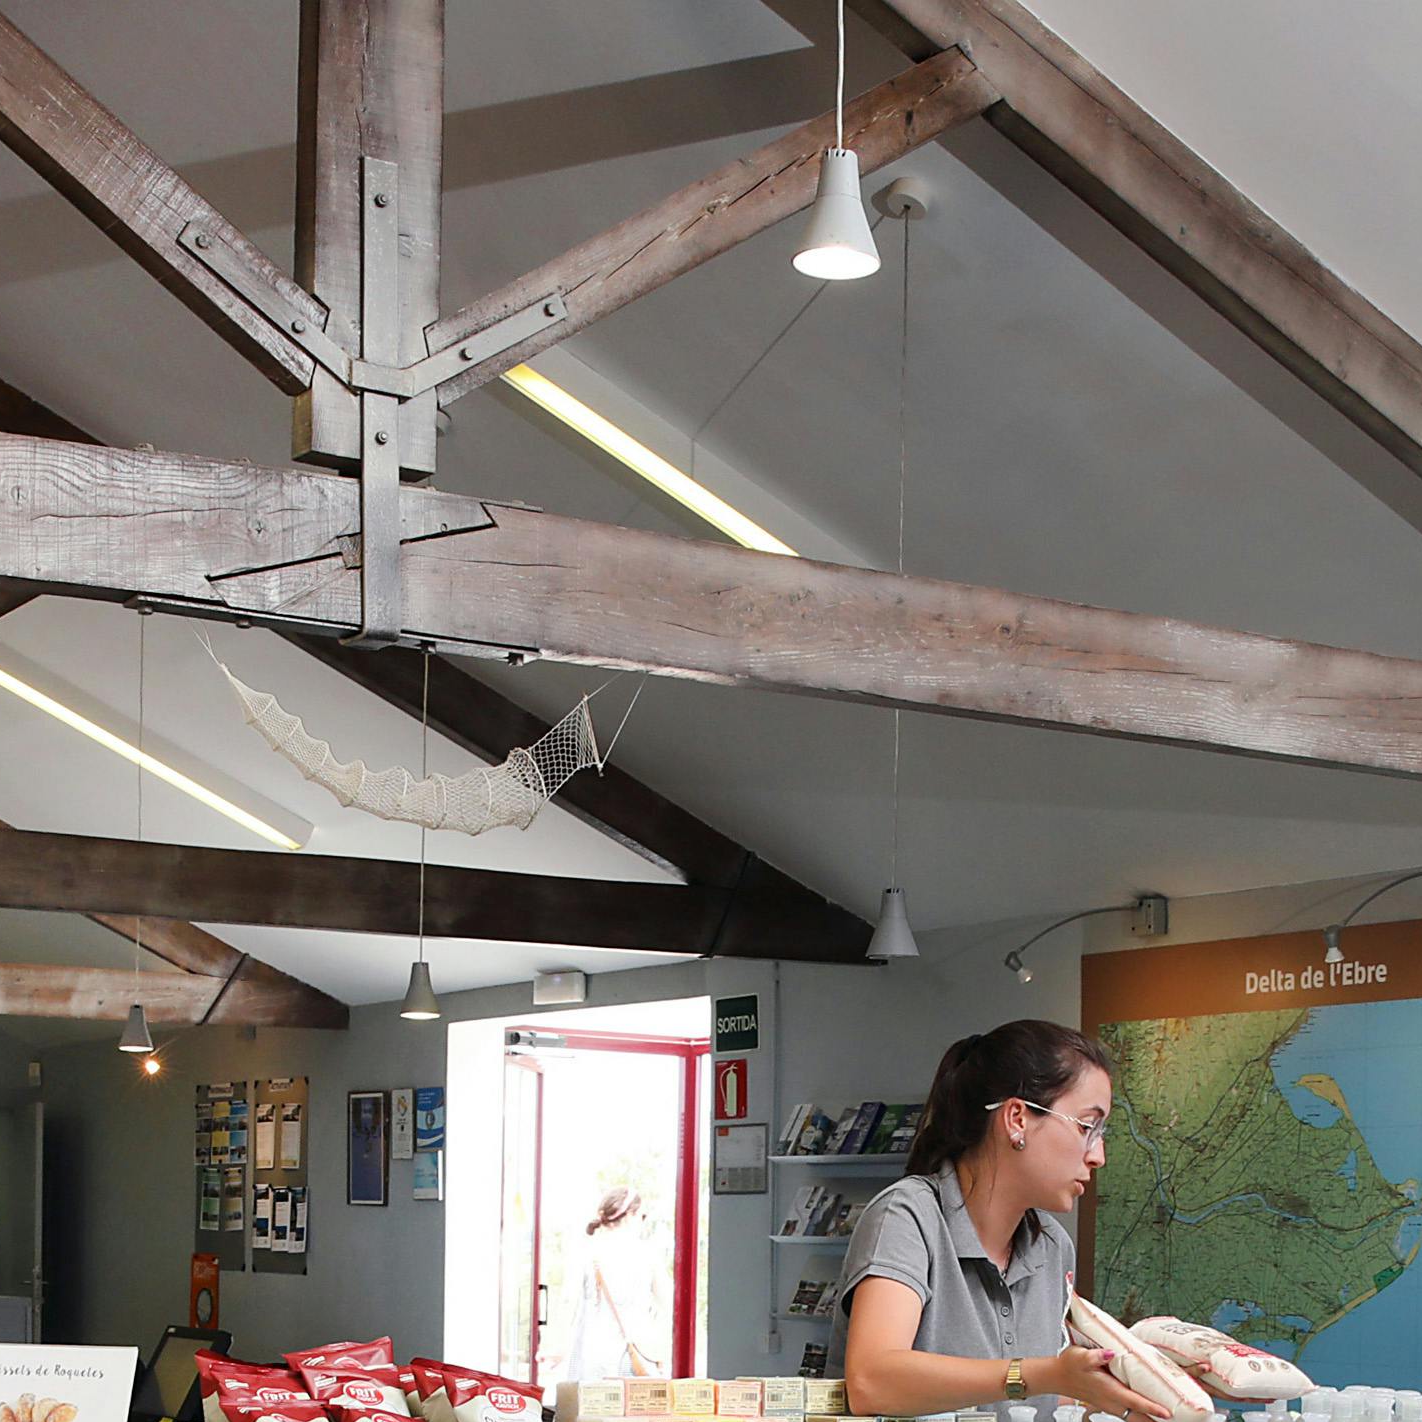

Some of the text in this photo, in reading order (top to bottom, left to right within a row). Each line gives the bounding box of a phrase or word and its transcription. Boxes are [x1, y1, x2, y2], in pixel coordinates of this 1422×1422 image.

[1245, 962, 1387, 994] Delta de l'Ebre
[717, 1014, 757, 1034] SORTIDA
[35, 1364, 50, 1376] de
[53, 1364, 105, 1380] Roquetes
[263, 1391, 291, 1401] FRIT
[349, 1387, 377, 1399] FRIT
[491, 1393, 520, 1404] FRIT
